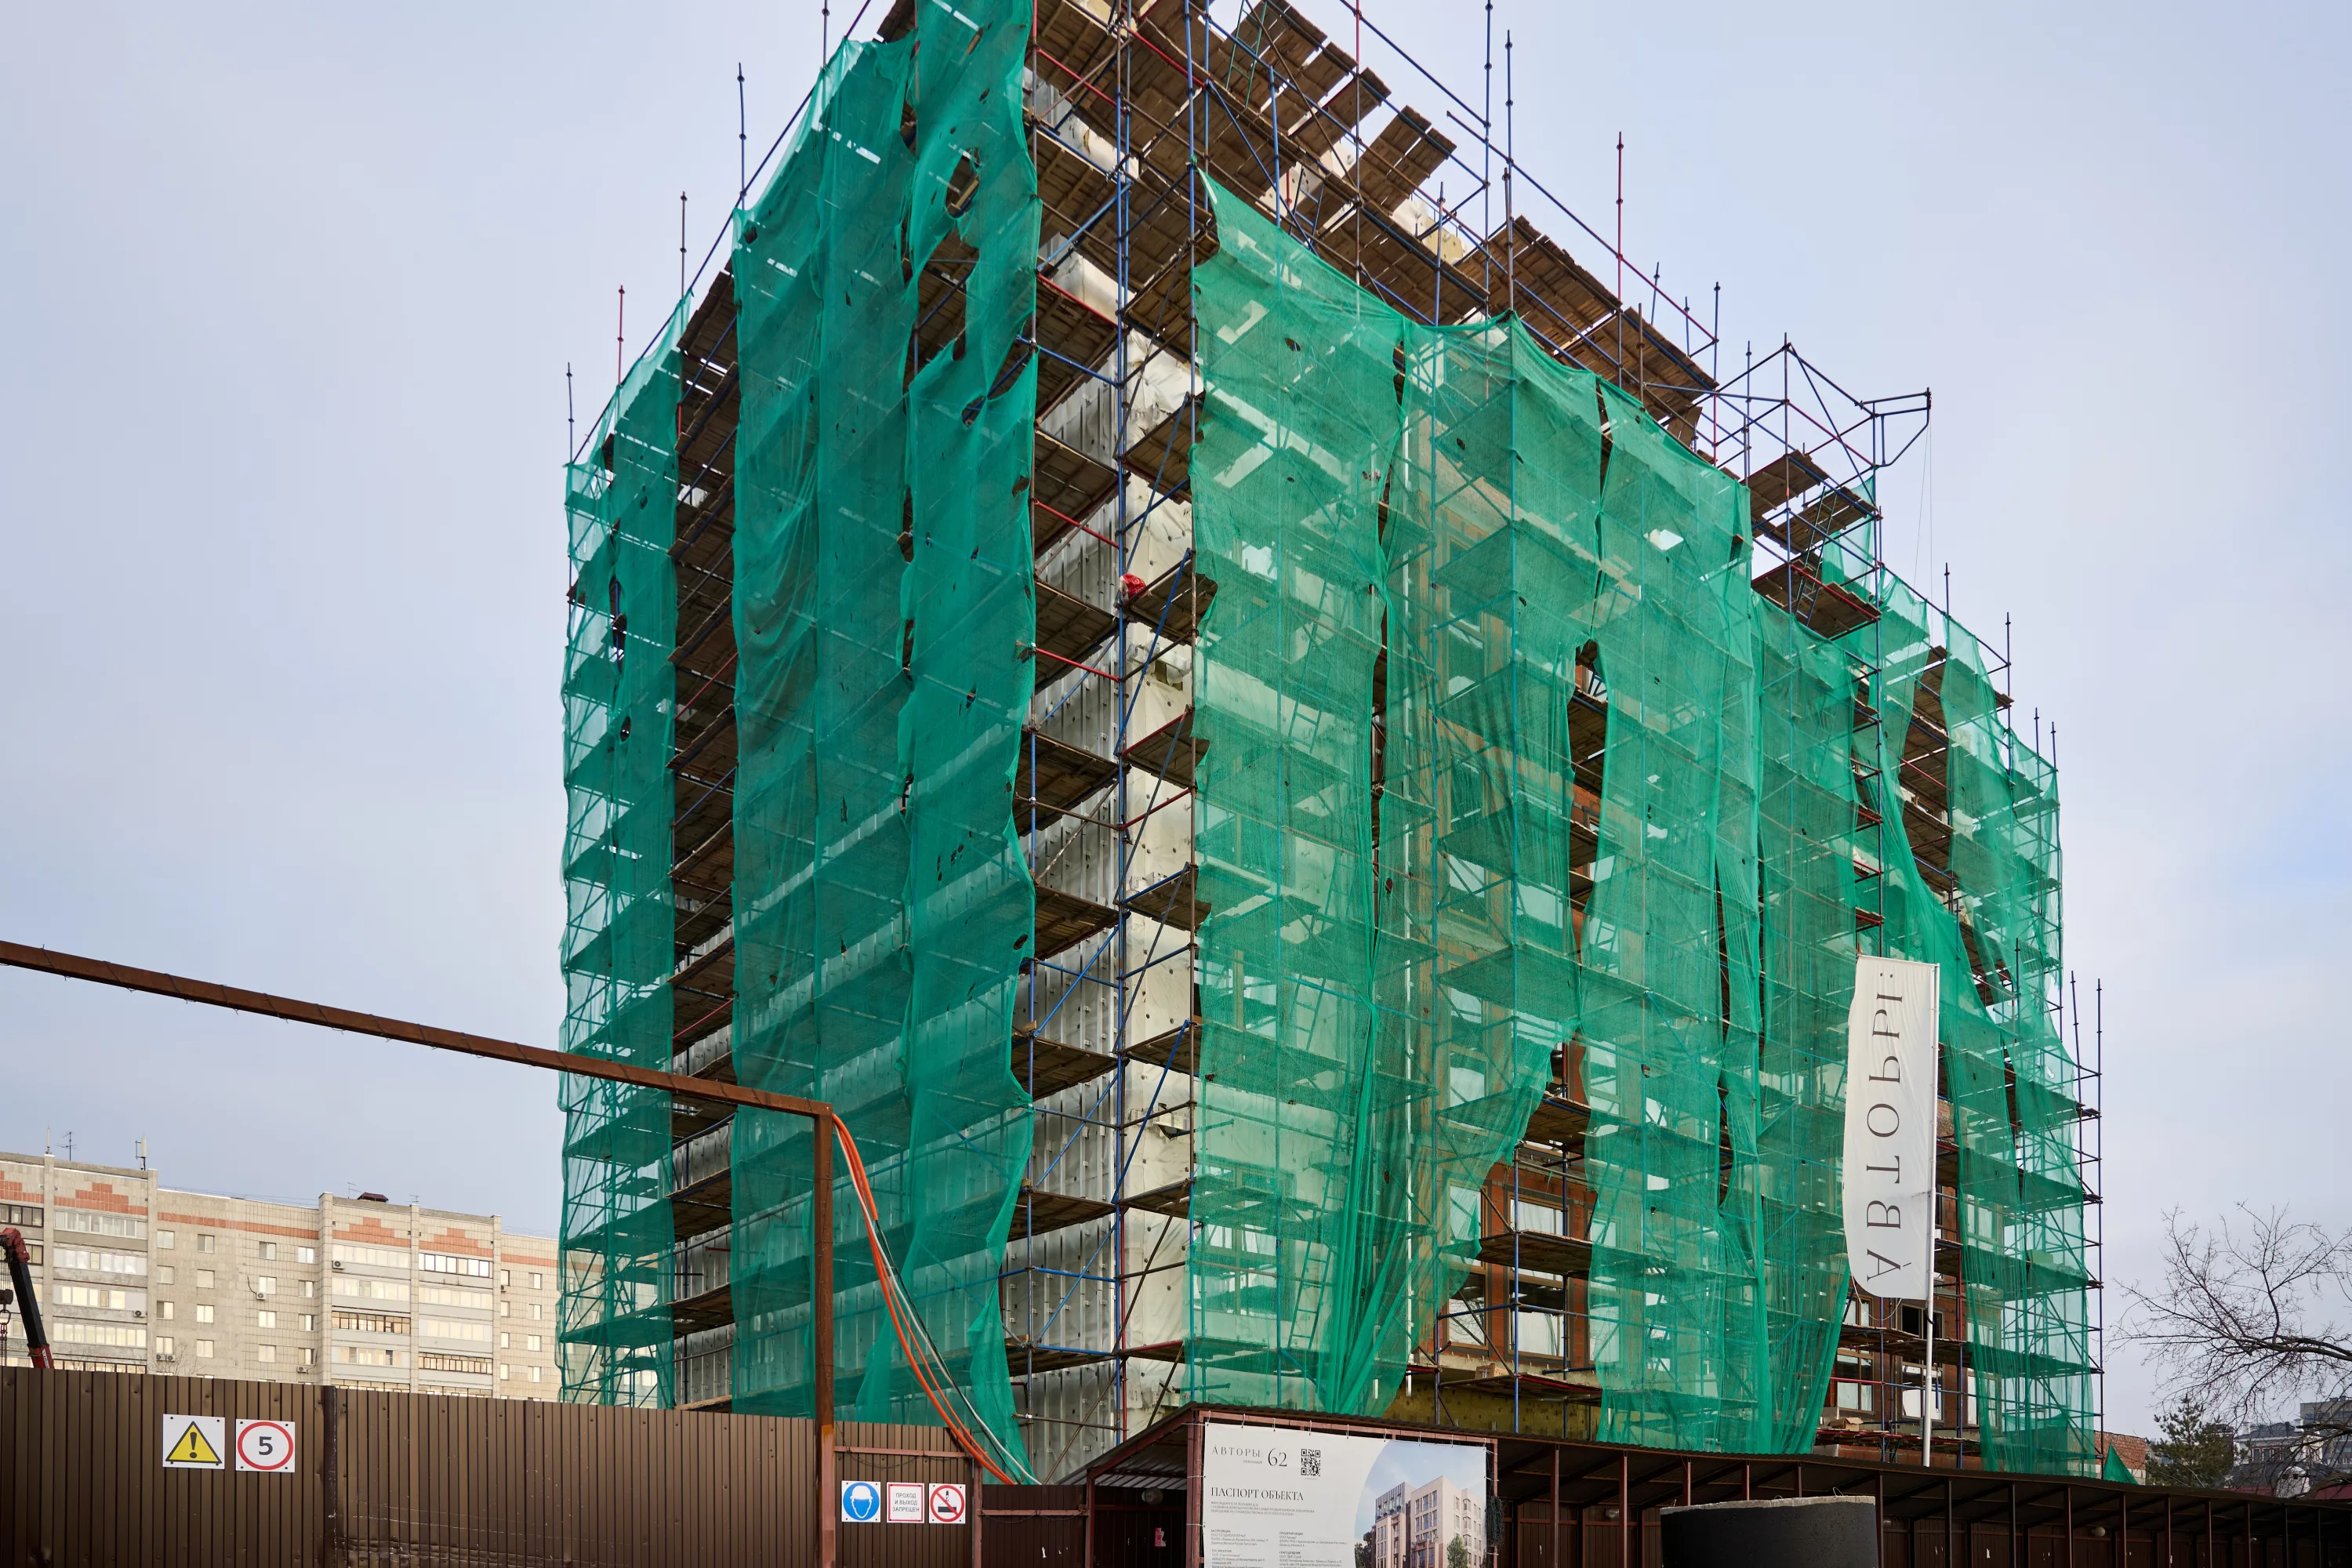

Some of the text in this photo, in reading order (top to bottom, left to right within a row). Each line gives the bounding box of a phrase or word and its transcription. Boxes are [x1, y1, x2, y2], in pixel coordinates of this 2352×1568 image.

[258, 1436, 273, 1455] 5
[1268, 1448, 1287, 1467] 62
[1211, 1487, 1304, 1501] ПАСПОРТ ОБЪЕКТА
